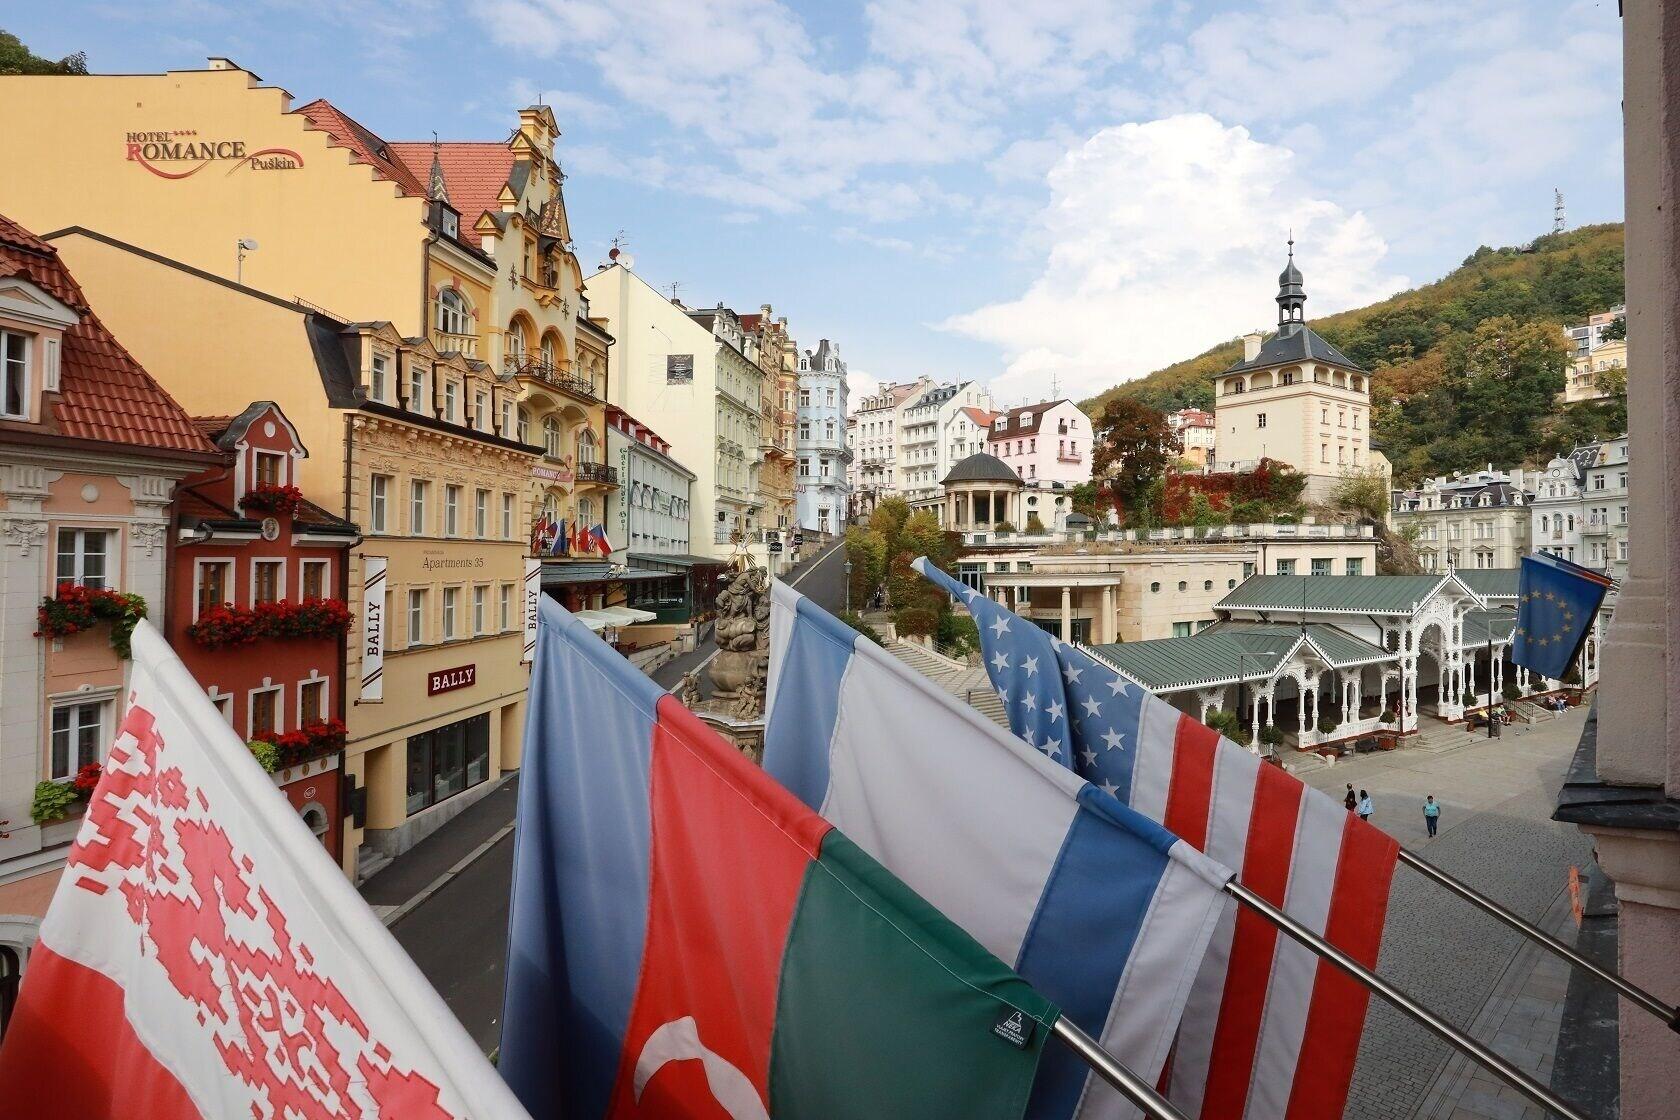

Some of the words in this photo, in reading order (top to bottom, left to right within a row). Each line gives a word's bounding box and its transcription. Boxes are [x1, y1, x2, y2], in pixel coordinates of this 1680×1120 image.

[126, 132, 174, 143] HOTEL
[127, 141, 247, 161] ROMANCE
[251, 156, 296, 170] Puškin
[422, 557, 473, 571] Apartments
[474, 557, 485, 568] 35
[528, 590, 537, 630] BALLY
[367, 601, 381, 656] BALLY
[432, 668, 474, 691] BALLY
